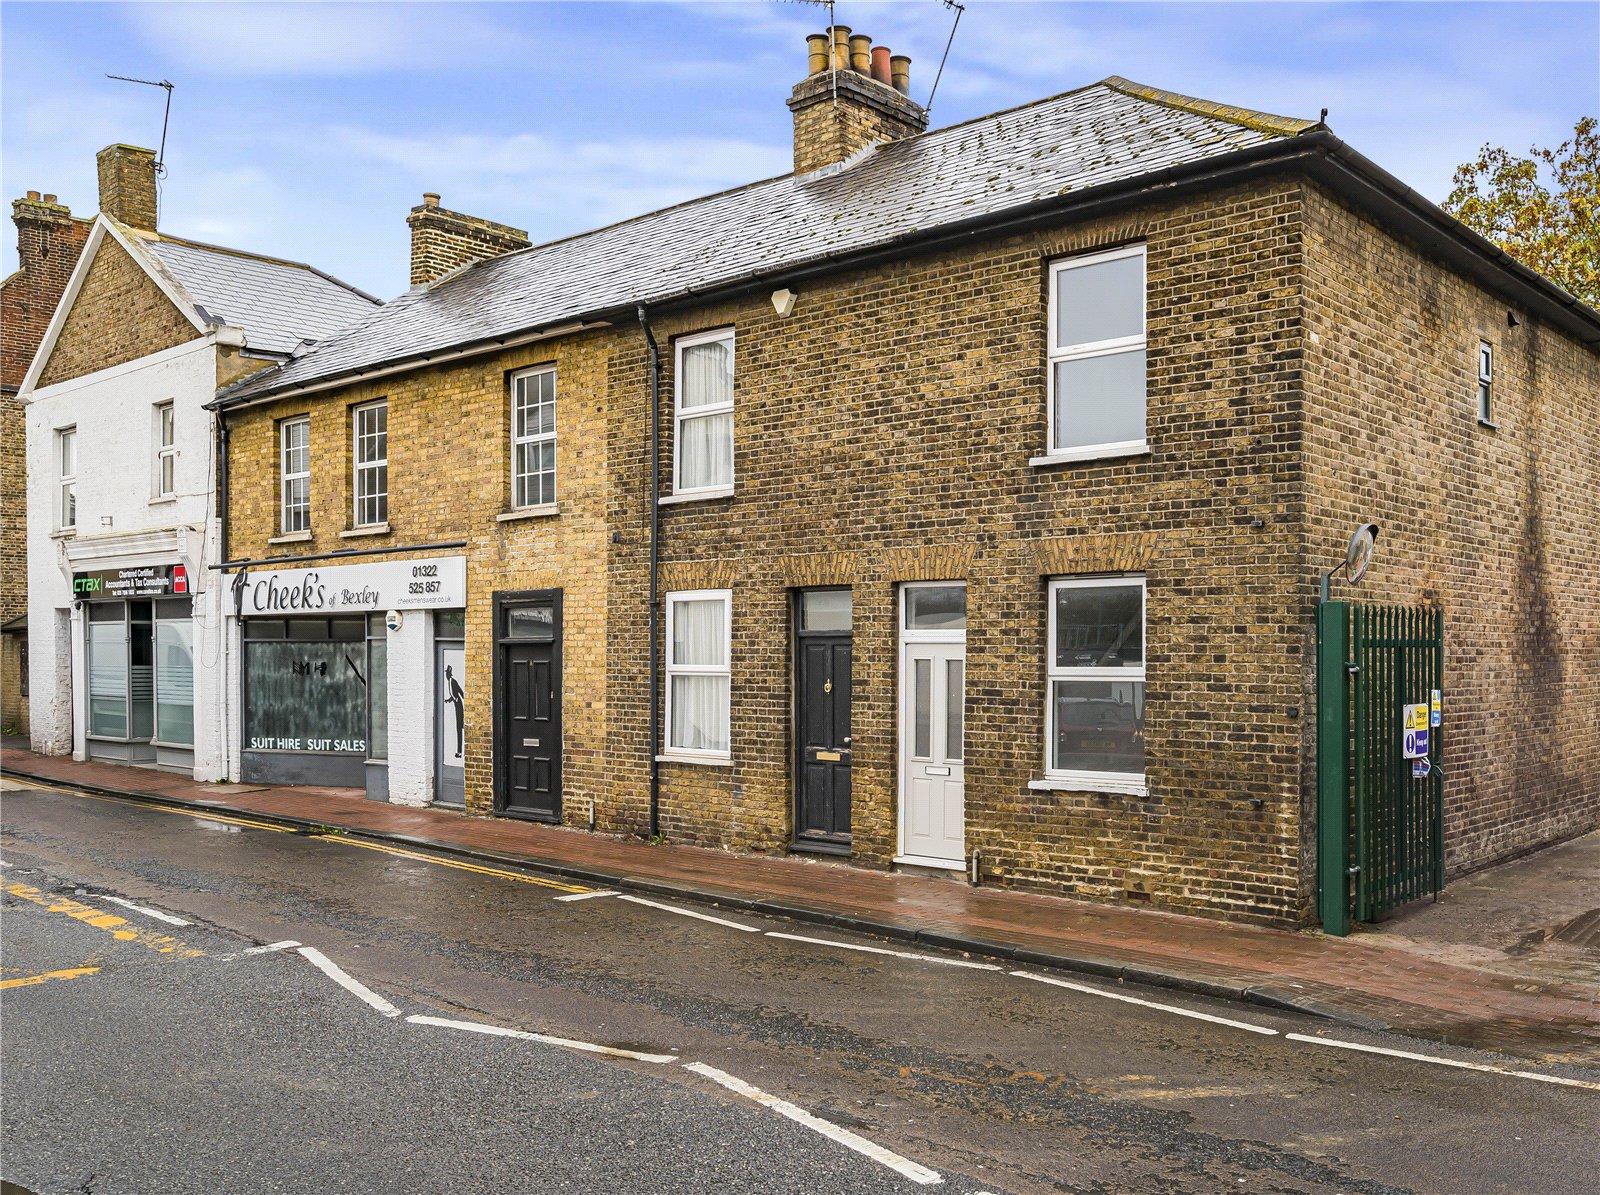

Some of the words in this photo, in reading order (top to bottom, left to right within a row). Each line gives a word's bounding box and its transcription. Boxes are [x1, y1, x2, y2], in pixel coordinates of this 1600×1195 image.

[412, 565, 438, 578] 01322
[105, 579, 131, 589] Accountants
[131, 578, 135, 587] &
[135, 578, 143, 587] Tax
[143, 578, 169, 586] Consultants
[408, 582, 424, 594] 525
[425, 581, 441, 593] 857
[253, 572, 325, 611] Cheek's
[328, 592, 336, 608] of
[340, 585, 379, 609] Bexley
[251, 738, 275, 749] SUIT
[277, 738, 301, 749] HIRE
[307, 739, 331, 750] SUIT
[334, 740, 366, 751] SALES
